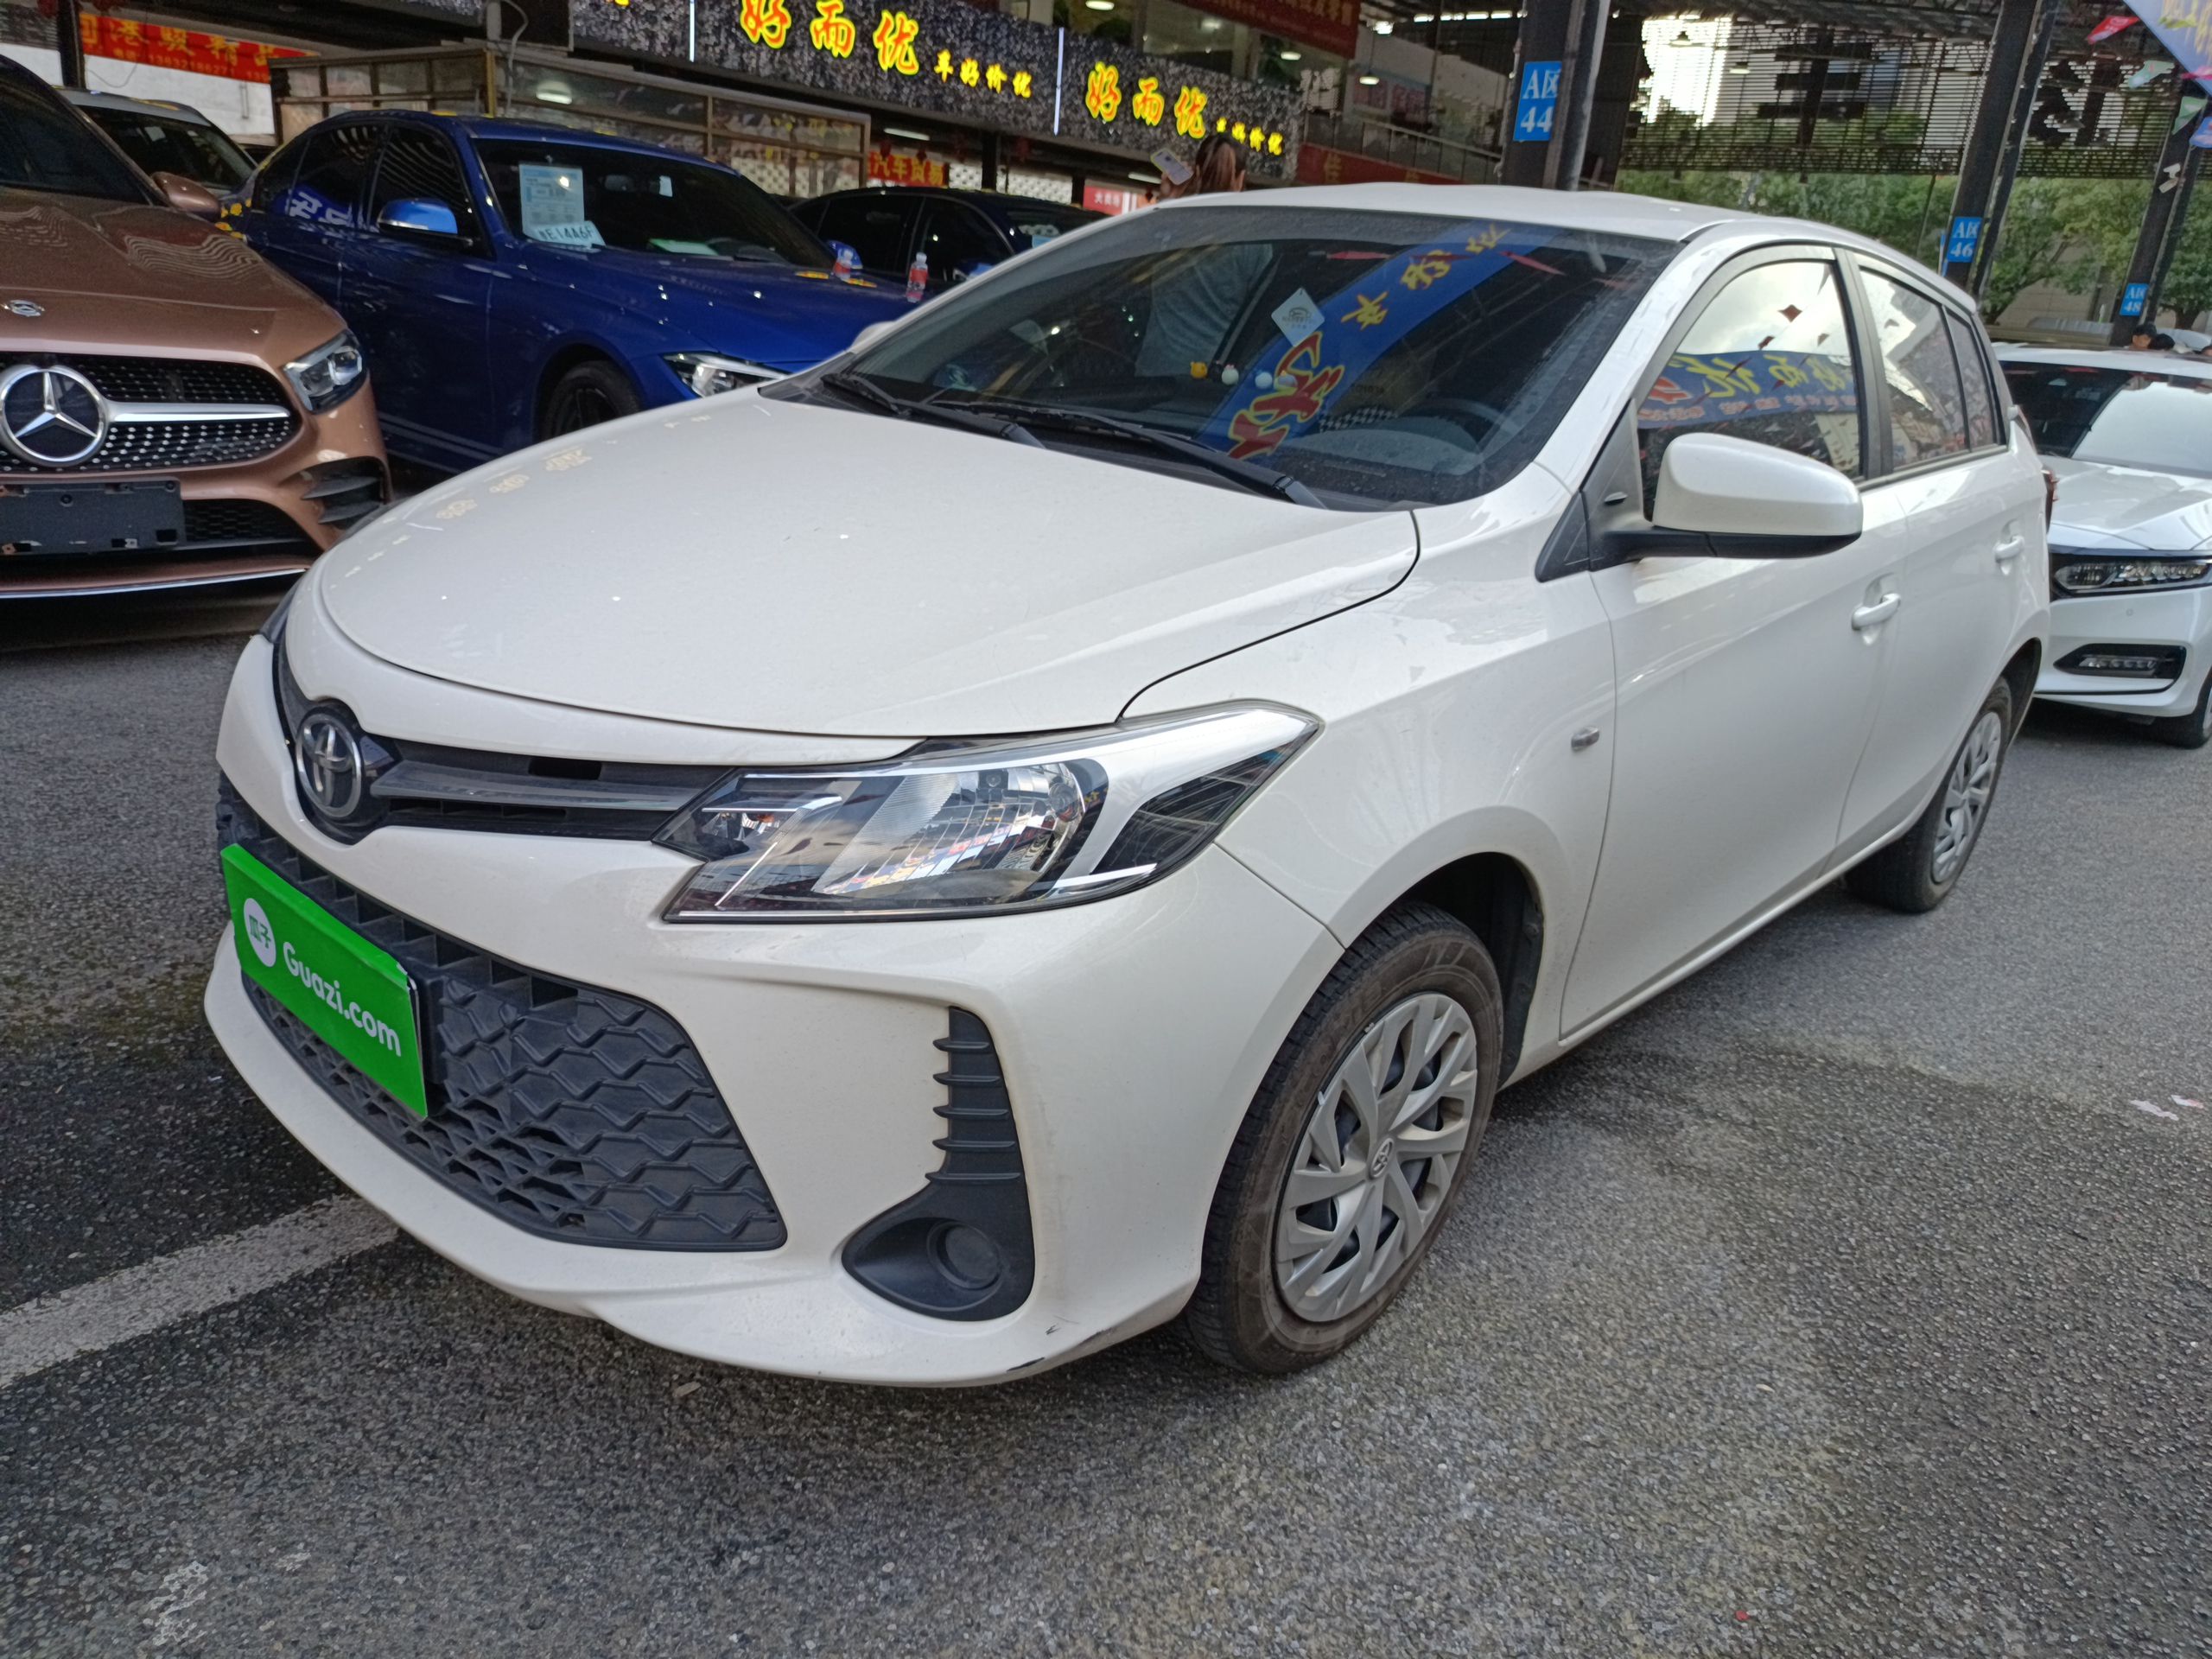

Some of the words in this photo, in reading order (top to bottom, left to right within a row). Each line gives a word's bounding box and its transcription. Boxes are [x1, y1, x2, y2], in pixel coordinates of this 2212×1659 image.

[740, 0, 920, 75] 好而优
[1085, 61, 1208, 139] 好而优
[1521, 105, 1554, 133] 44
[1950, 242, 1974, 257] 46
[283, 941, 402, 1058] Guazi.com
